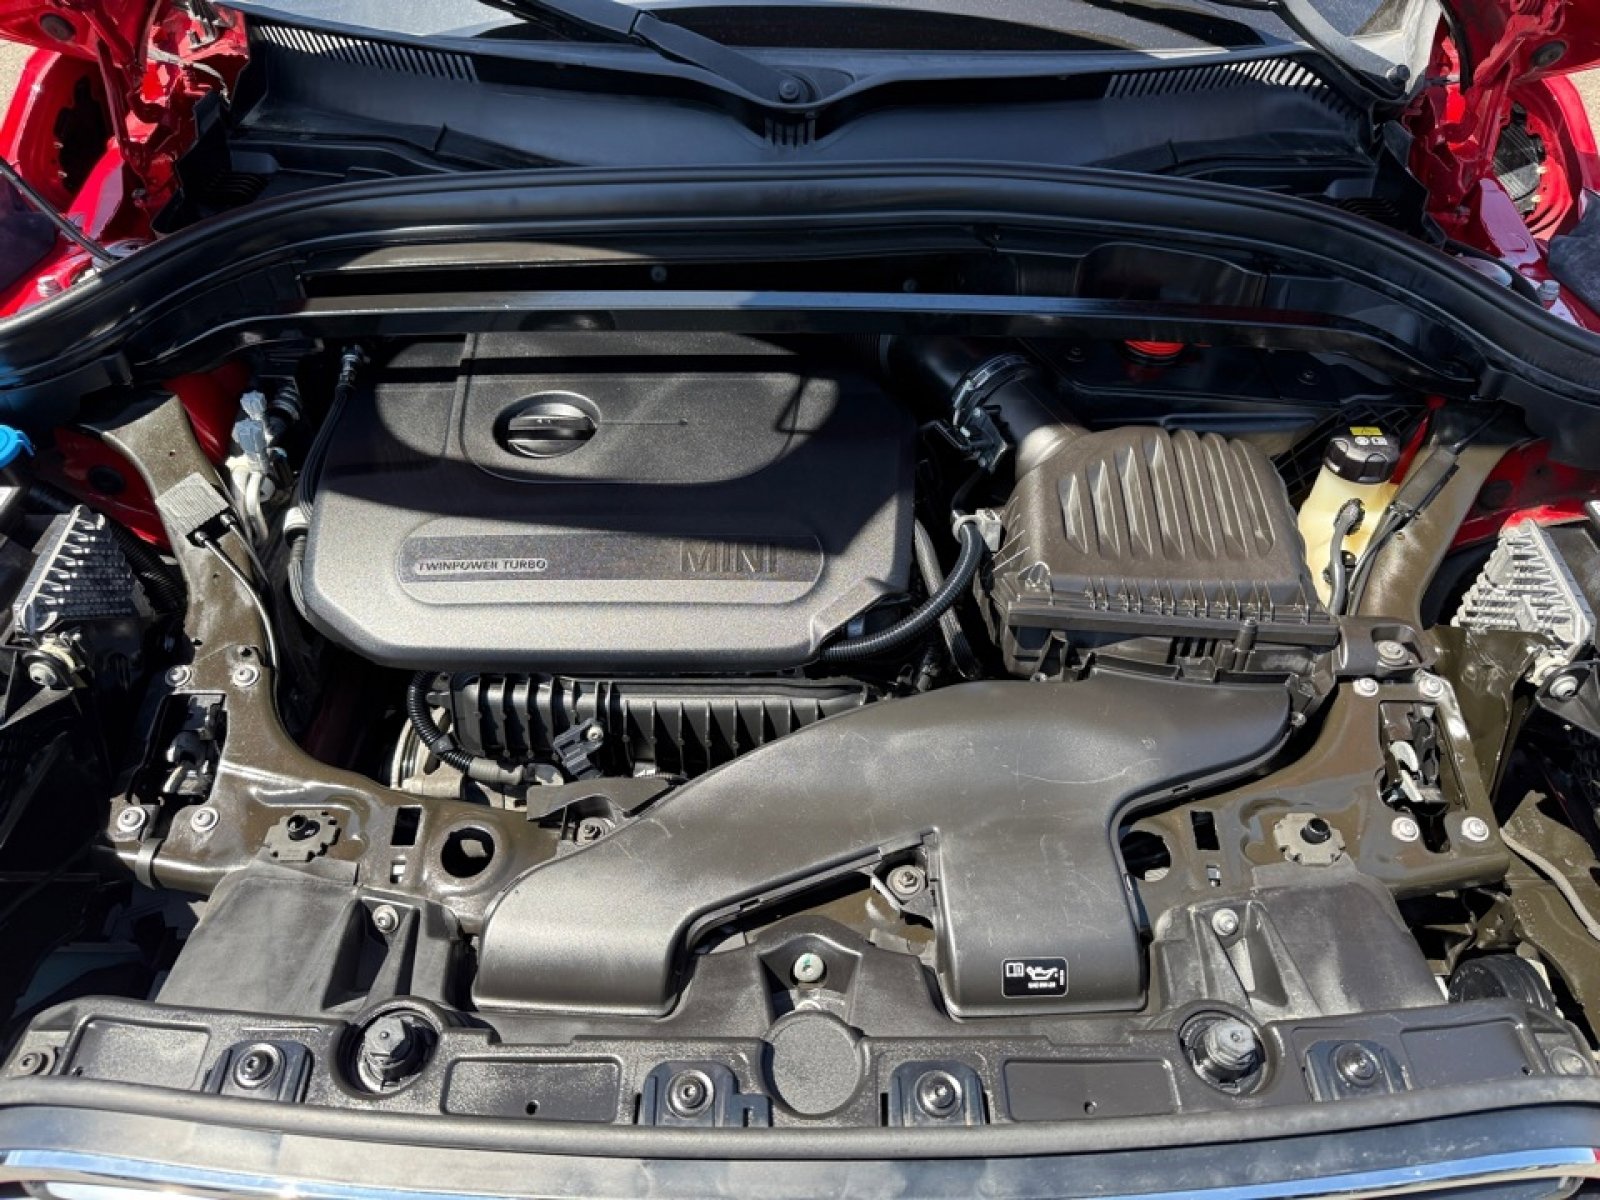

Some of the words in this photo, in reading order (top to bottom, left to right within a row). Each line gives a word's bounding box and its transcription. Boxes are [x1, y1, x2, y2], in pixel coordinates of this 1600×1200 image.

[419, 559, 498, 571] TWINPOWER
[503, 559, 546, 570] TURBO
[680, 541, 779, 573] MINI
